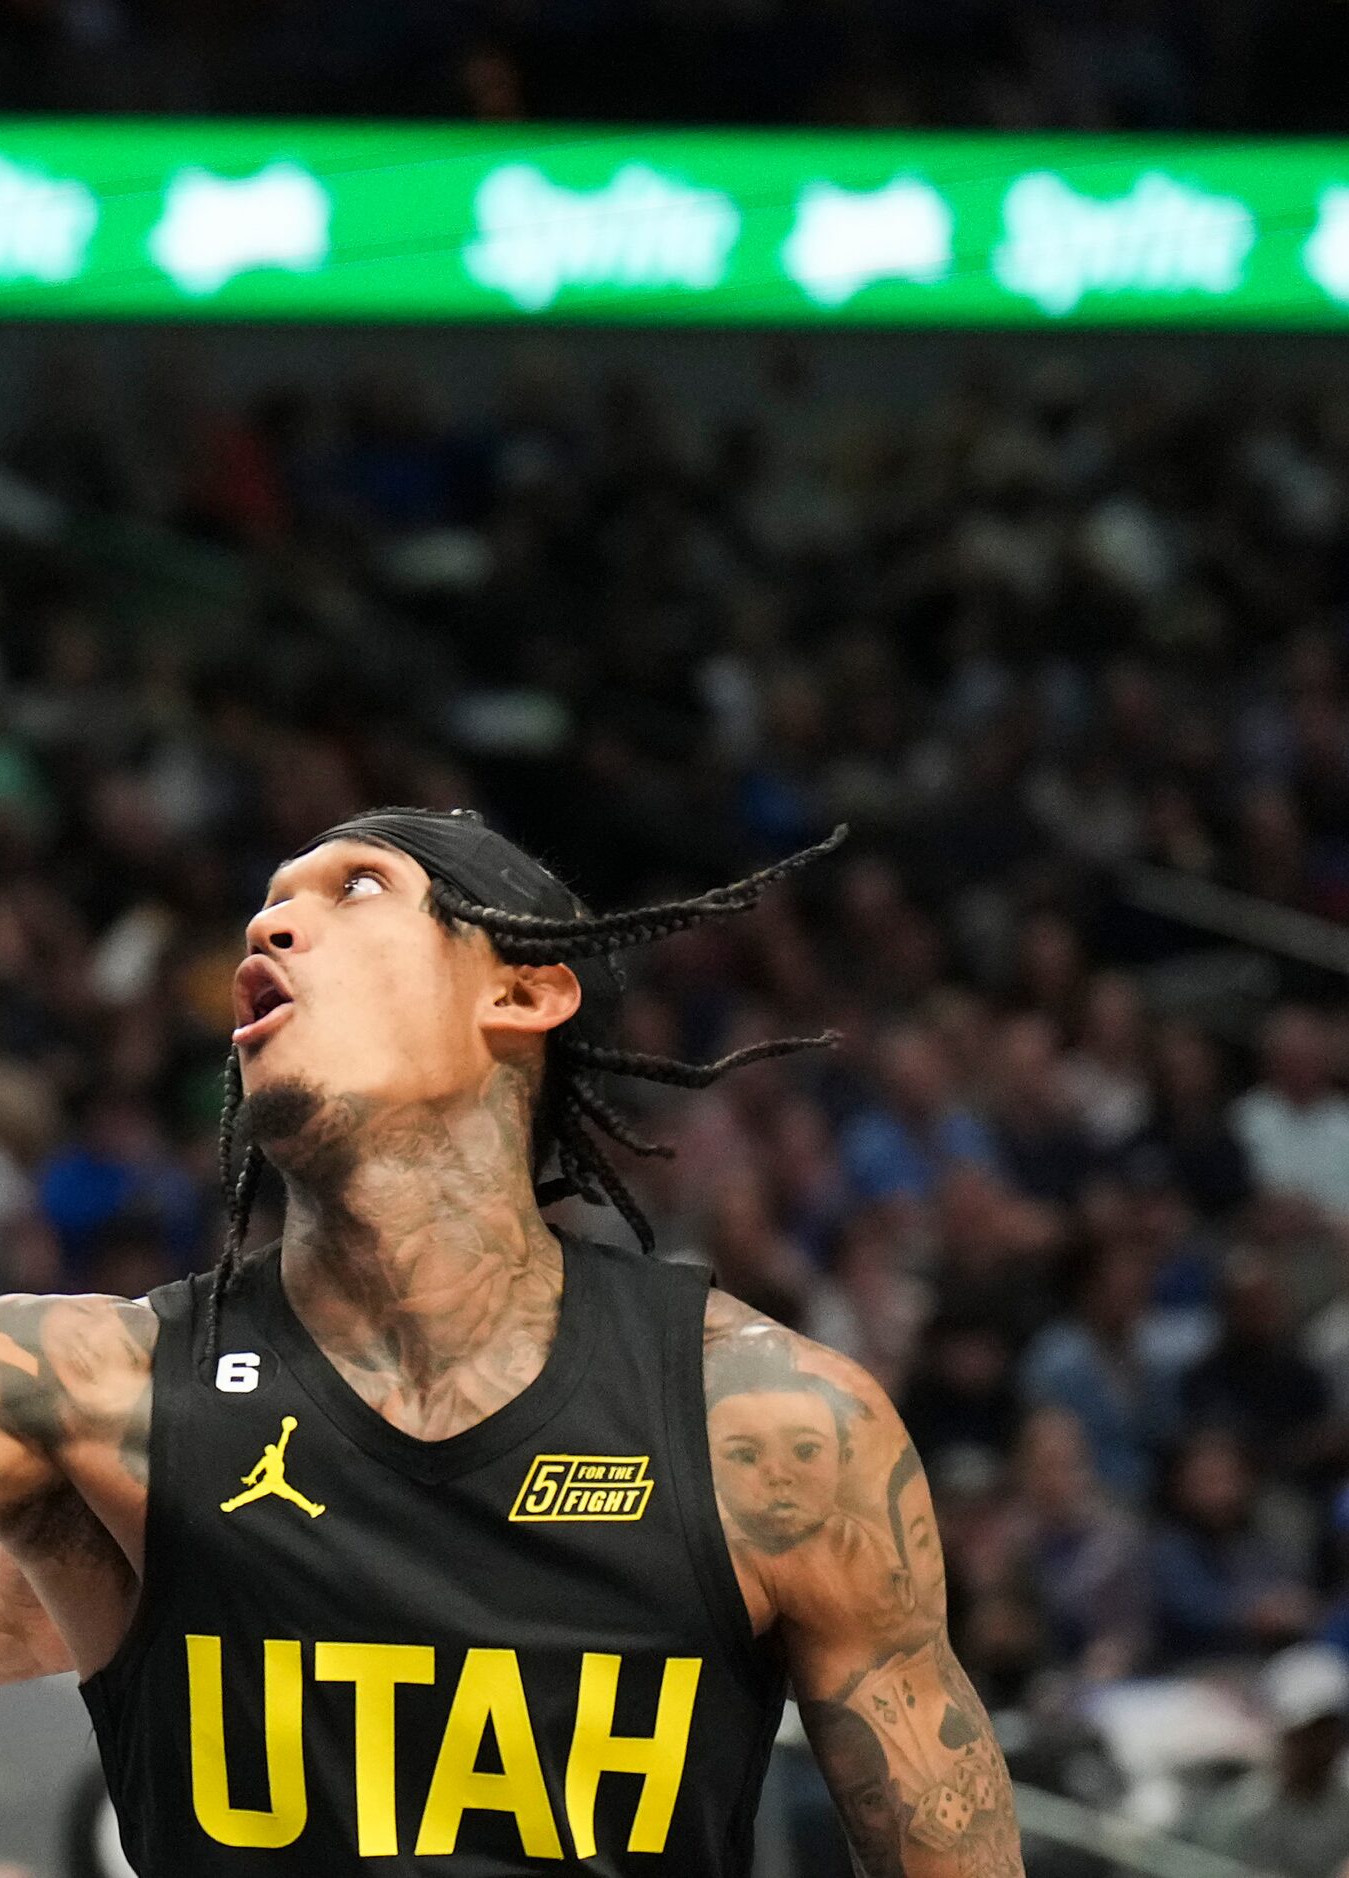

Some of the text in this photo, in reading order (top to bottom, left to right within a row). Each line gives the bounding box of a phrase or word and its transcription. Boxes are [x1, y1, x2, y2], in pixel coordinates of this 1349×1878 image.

[215, 1352, 261, 1393] 6
[525, 1465, 565, 1514] 5
[577, 1465, 637, 1481] FOR THE
[563, 1490, 641, 1513] FIGHT
[185, 1634, 703, 1860] UTAH
